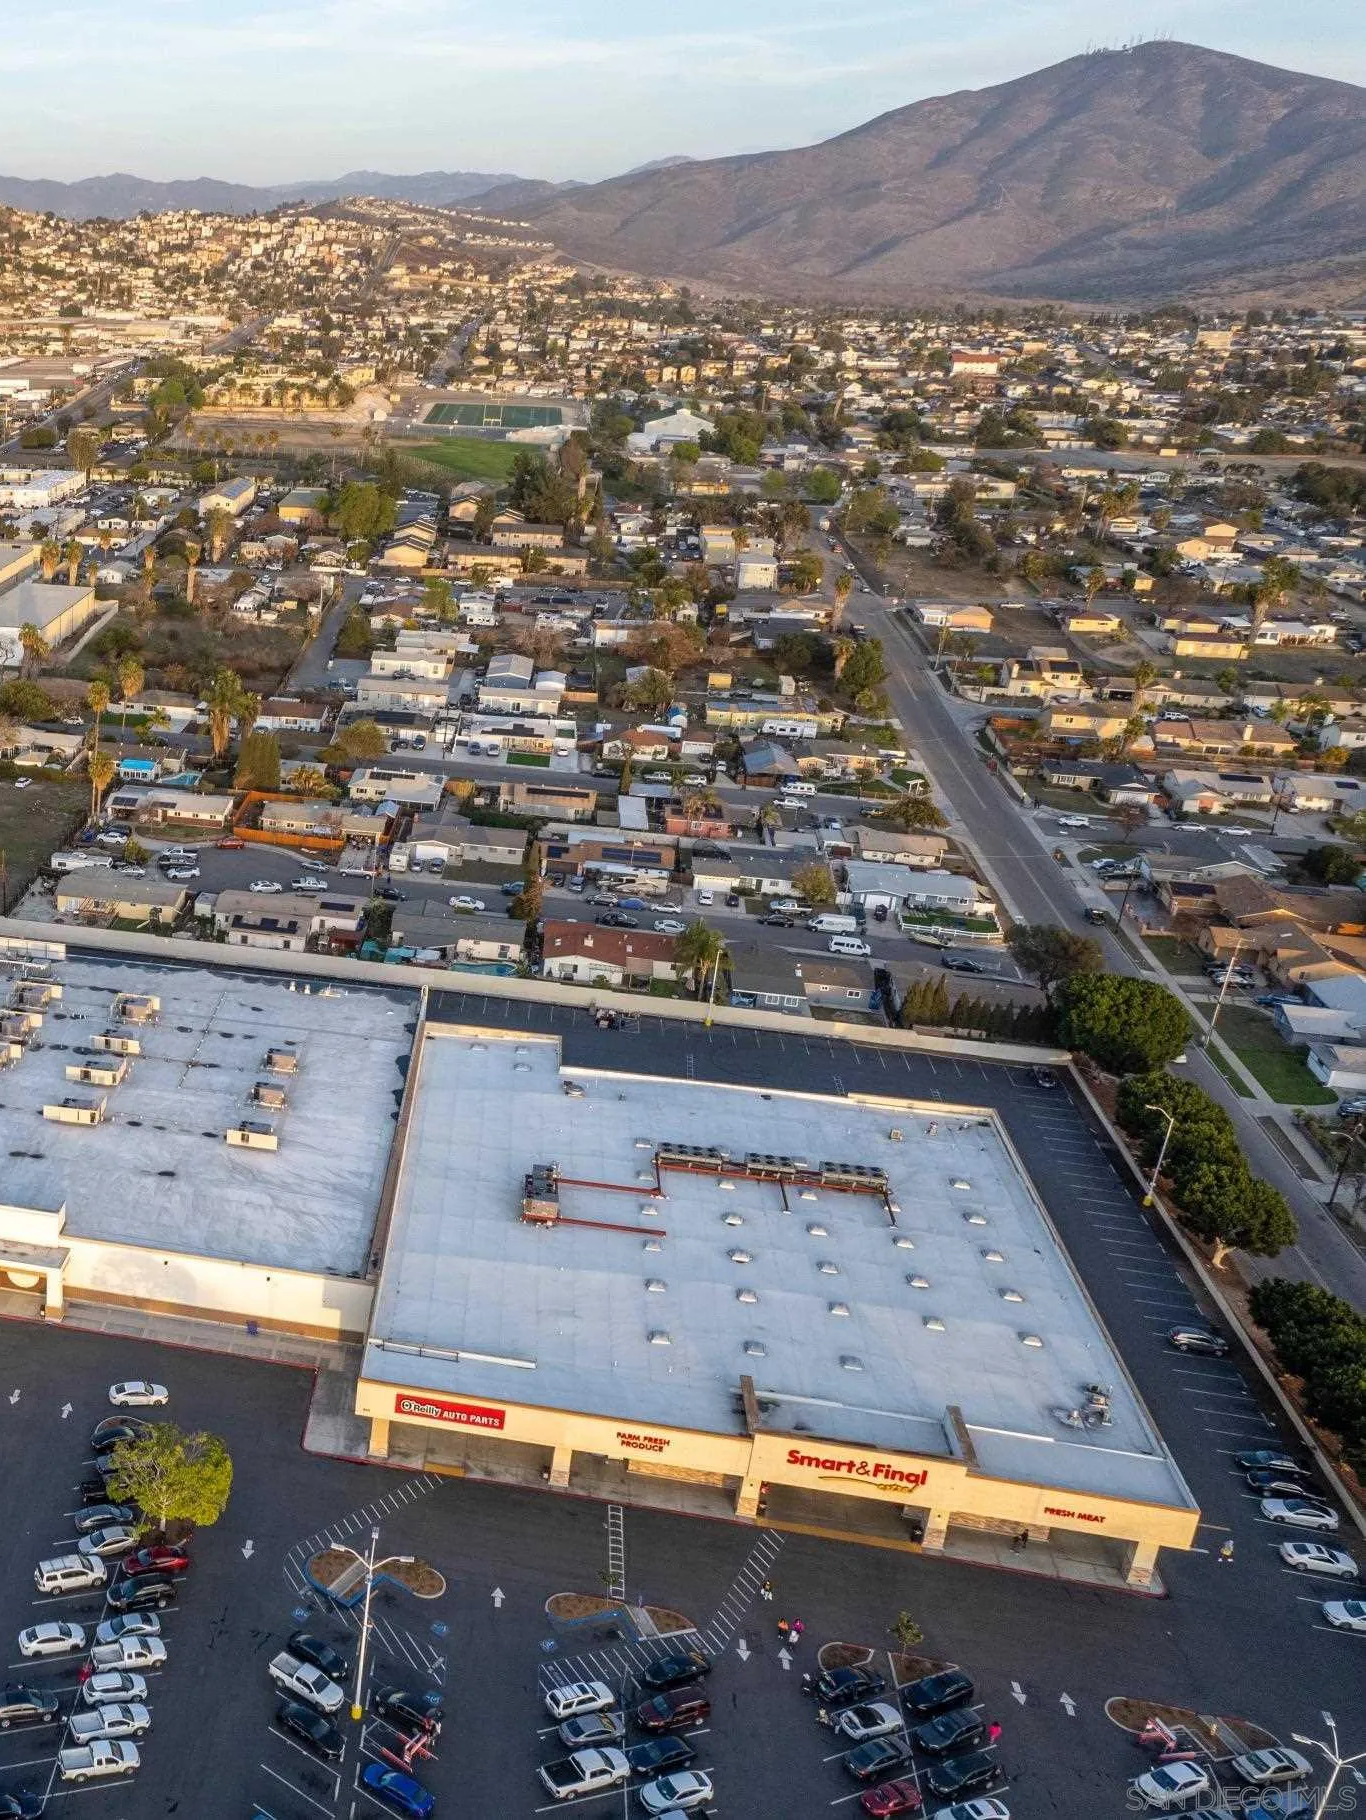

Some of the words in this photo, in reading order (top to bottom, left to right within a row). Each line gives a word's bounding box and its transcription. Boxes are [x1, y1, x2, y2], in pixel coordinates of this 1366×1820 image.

[443, 1411, 467, 1422] AUTO
[470, 1415, 500, 1426] PARTS
[621, 1440, 664, 1452] PRODUCE
[643, 1436, 670, 1446] FRESH
[1044, 1507, 1075, 1518] FRESH
[1077, 1513, 1106, 1523] MEAT
